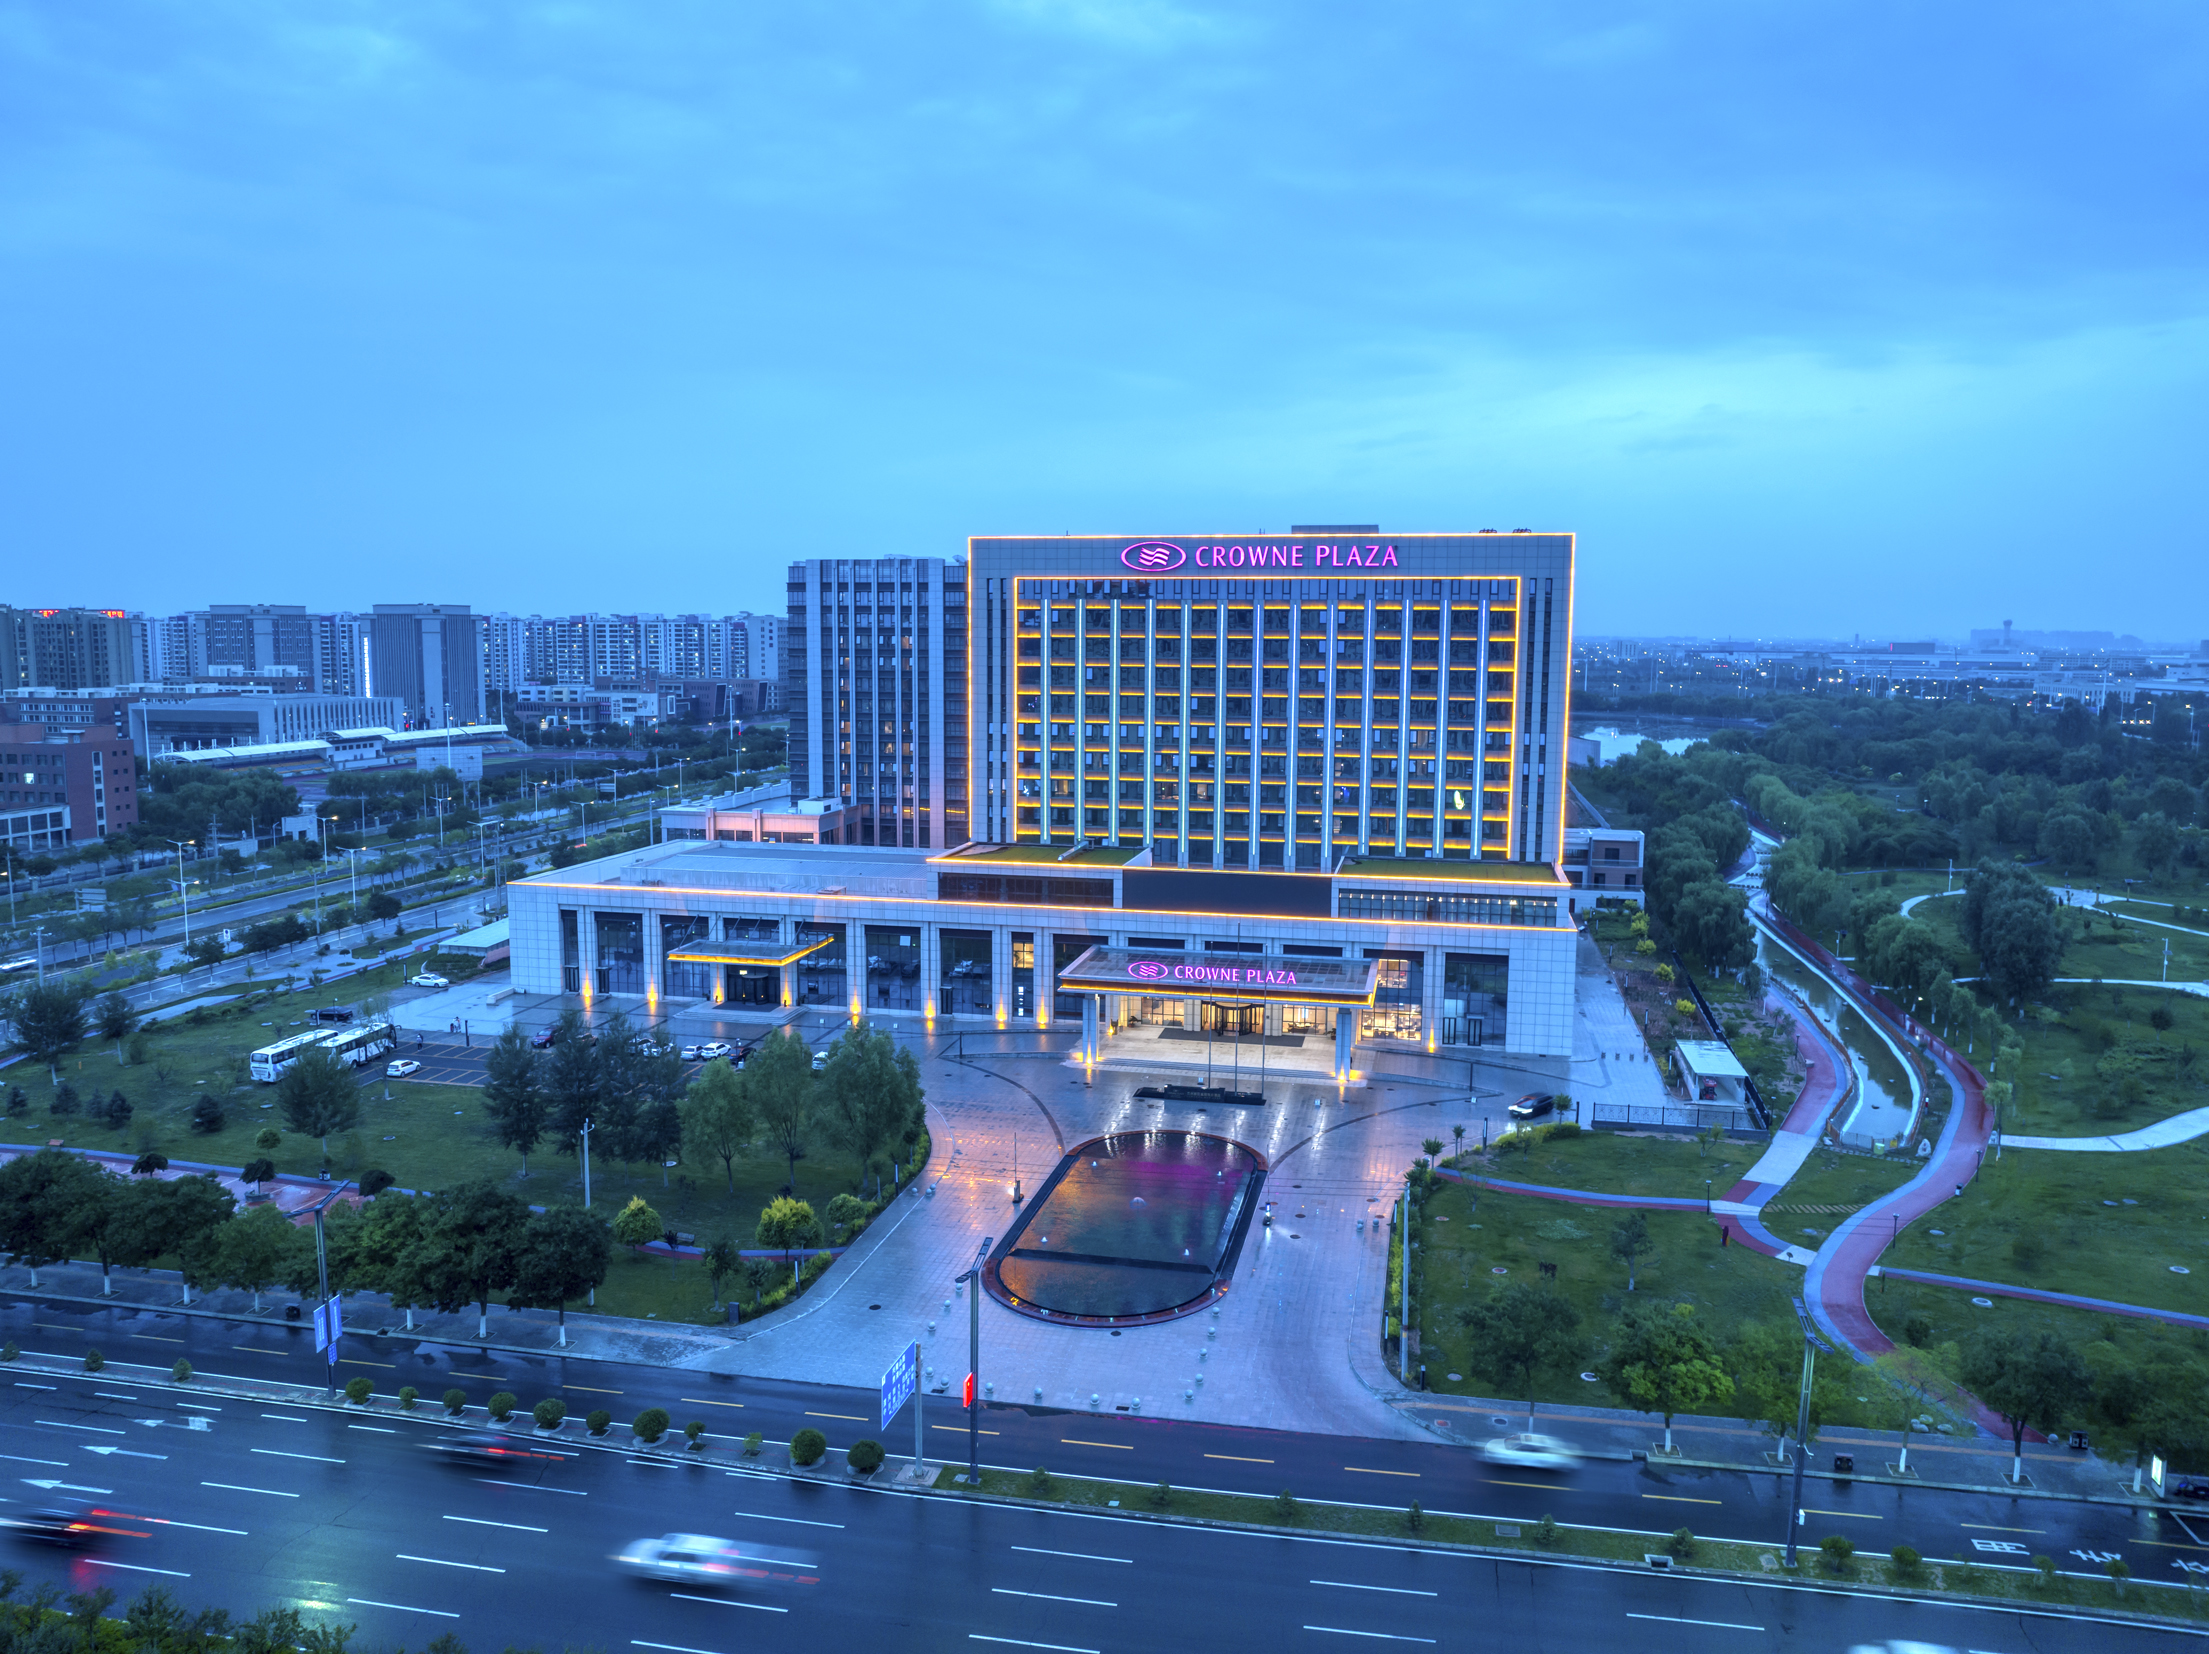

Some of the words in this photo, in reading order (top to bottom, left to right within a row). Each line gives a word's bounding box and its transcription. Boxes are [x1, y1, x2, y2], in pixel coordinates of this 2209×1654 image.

[1195, 546, 1304, 568] CROWNE
[1315, 545, 1399, 567] PLAZA
[1174, 965, 1240, 982] CROWNE
[1247, 969, 1297, 985] PLAZA
